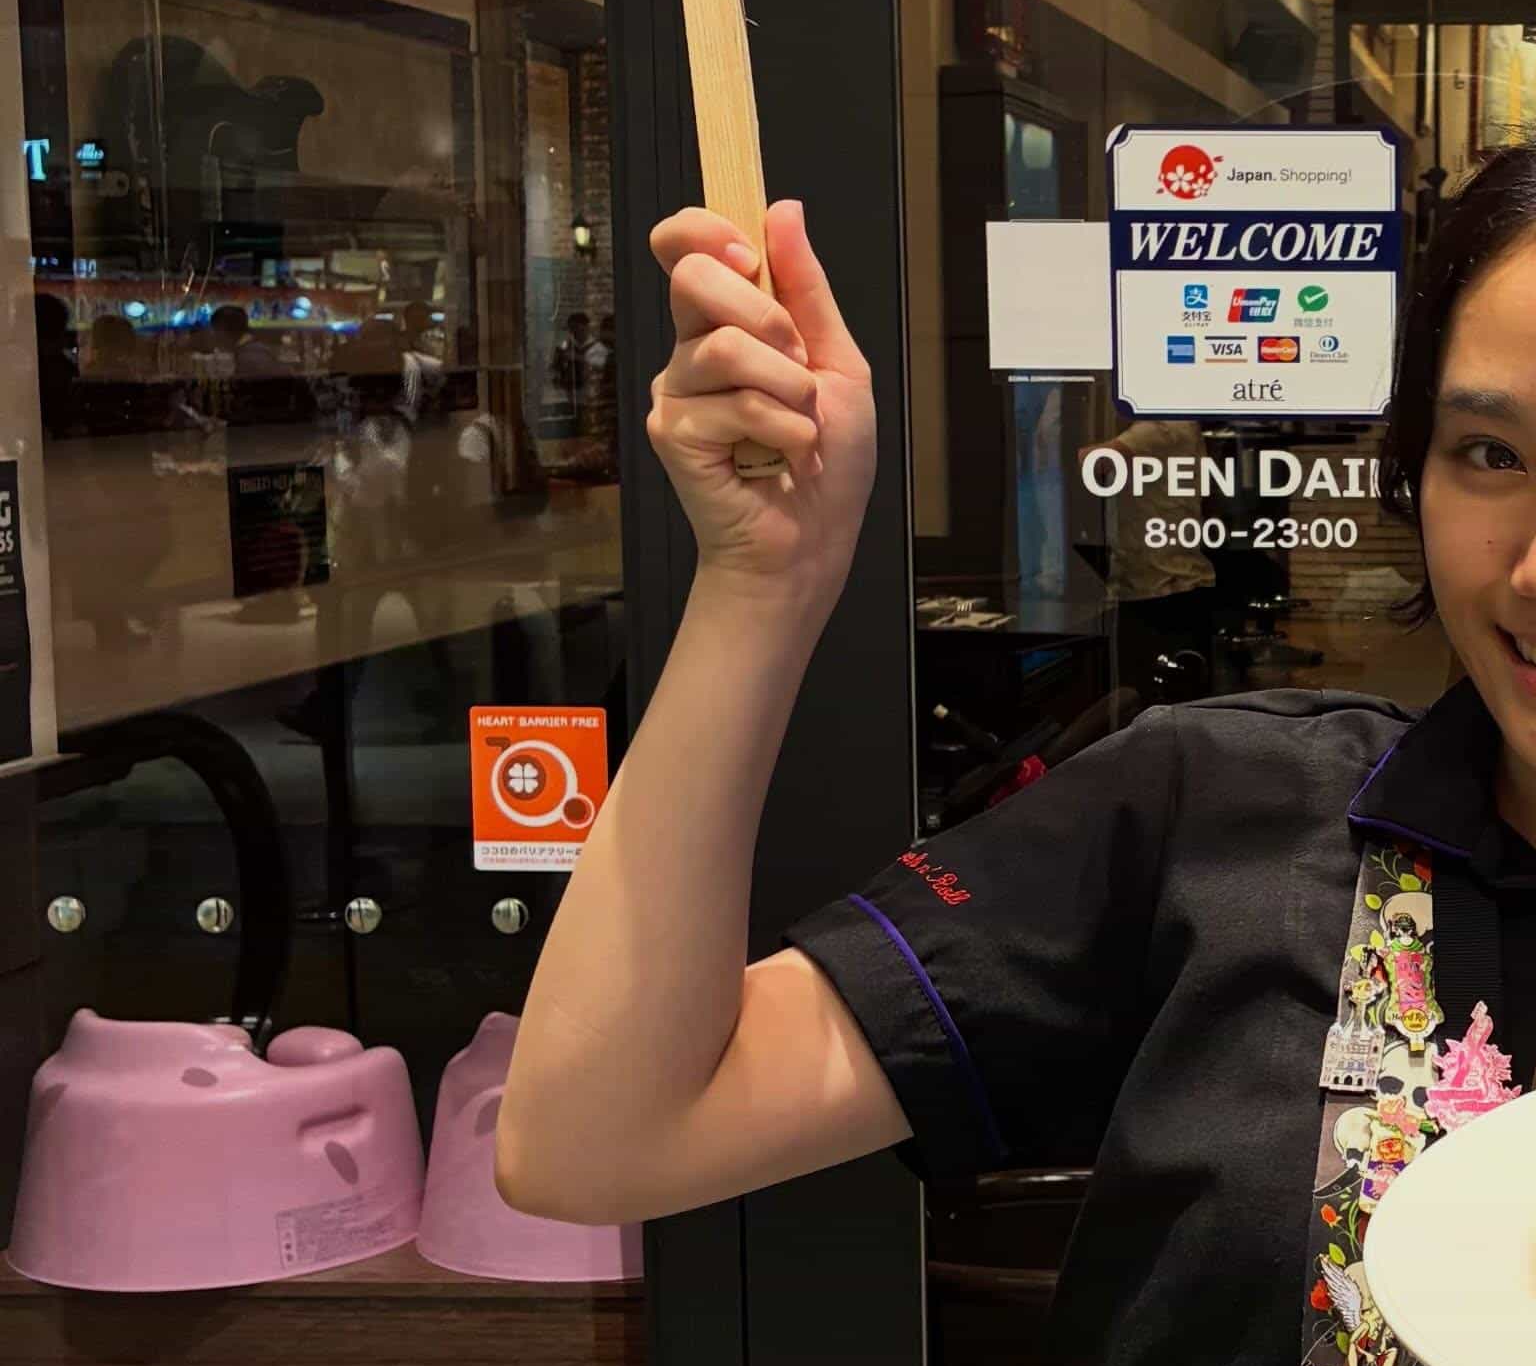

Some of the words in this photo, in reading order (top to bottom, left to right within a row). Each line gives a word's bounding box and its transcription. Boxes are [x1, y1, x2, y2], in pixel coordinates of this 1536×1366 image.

[1226, 167, 1277, 183] Japan.
[1280, 168, 1352, 184] Shopping!
[1129, 221, 1383, 262] WELCOME
[1211, 343, 1243, 356] VISA
[1232, 378, 1283, 401] atré
[1081, 447, 1236, 498] OPEN
[477, 715, 514, 727] HEART
[571, 716, 600, 728] FREE
